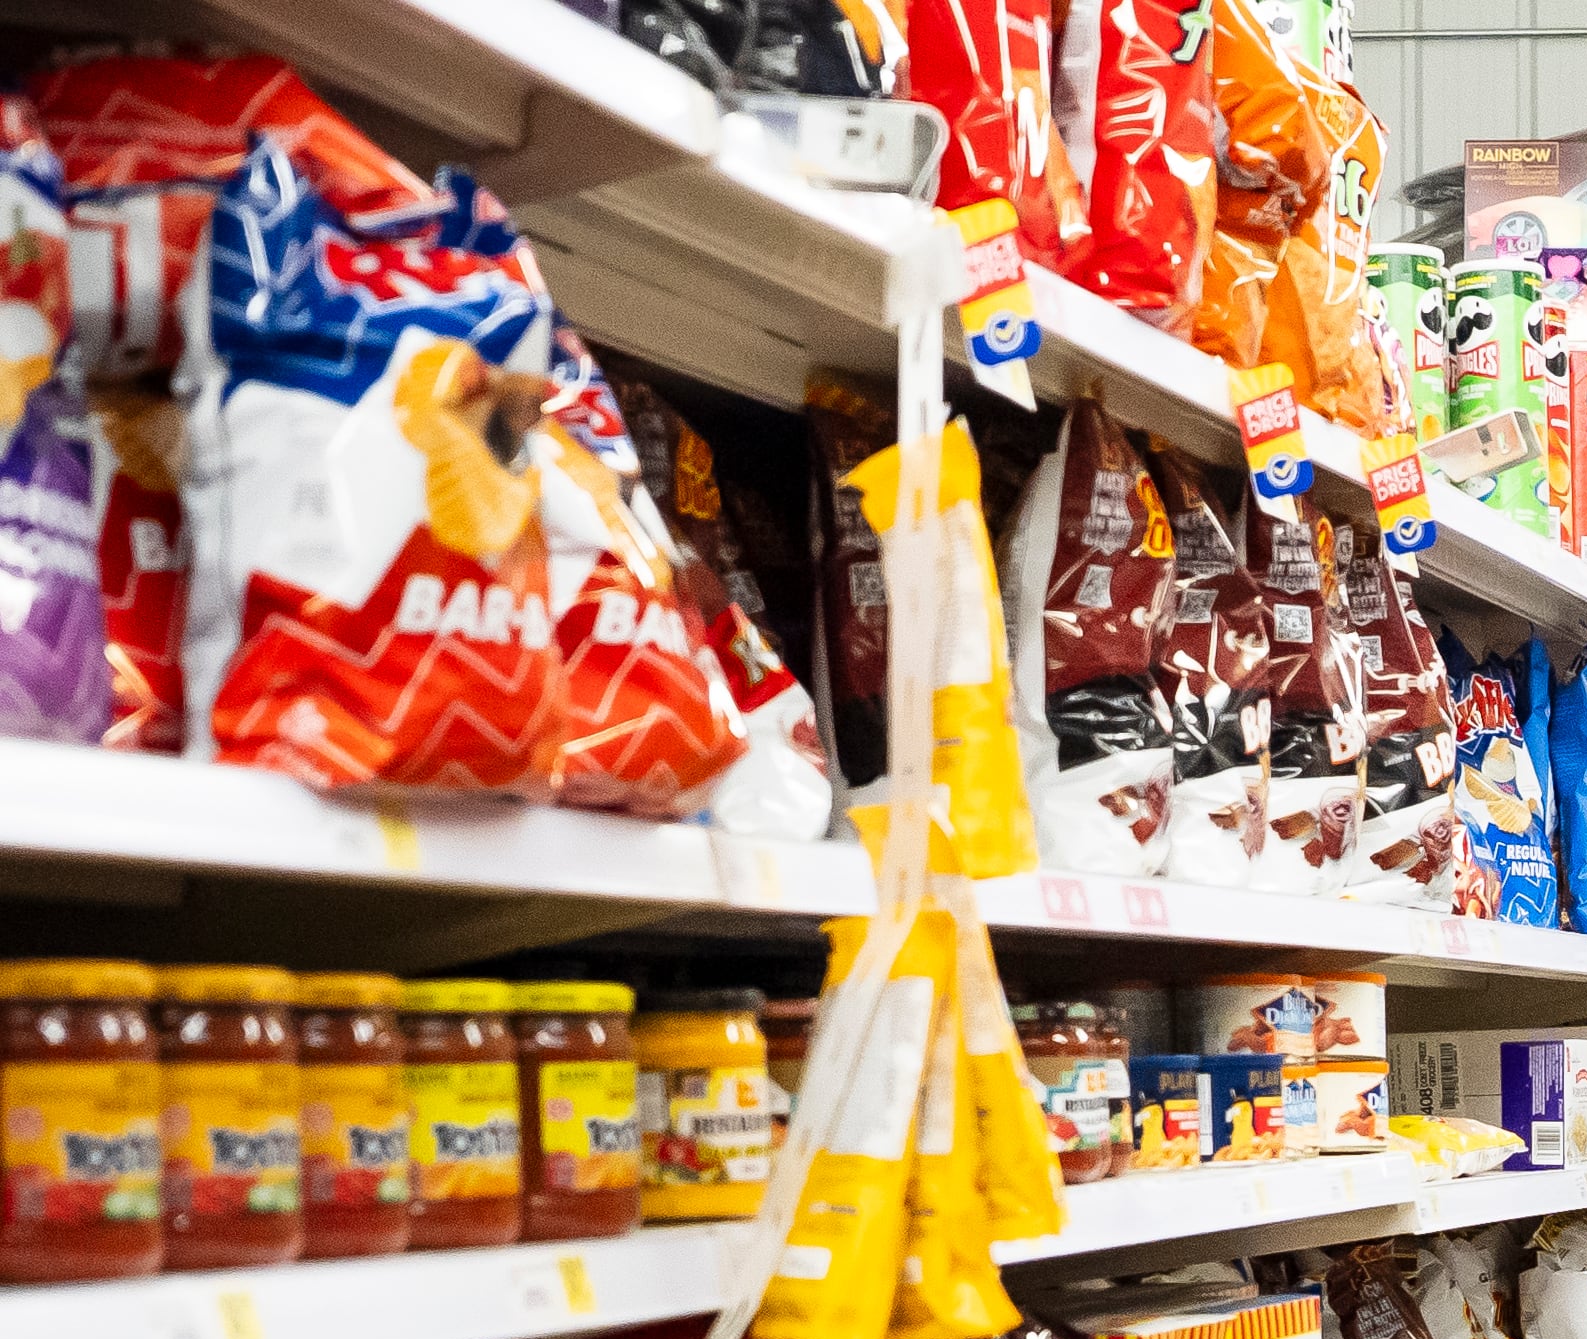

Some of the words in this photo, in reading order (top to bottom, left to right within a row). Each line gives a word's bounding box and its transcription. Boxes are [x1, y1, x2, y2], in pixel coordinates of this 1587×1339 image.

[1472, 147, 1552, 163] RAINBOW
[1372, 459, 1417, 486] PRICE
[1375, 475, 1422, 503] DROP
[1419, 1086, 1435, 1115] 408
